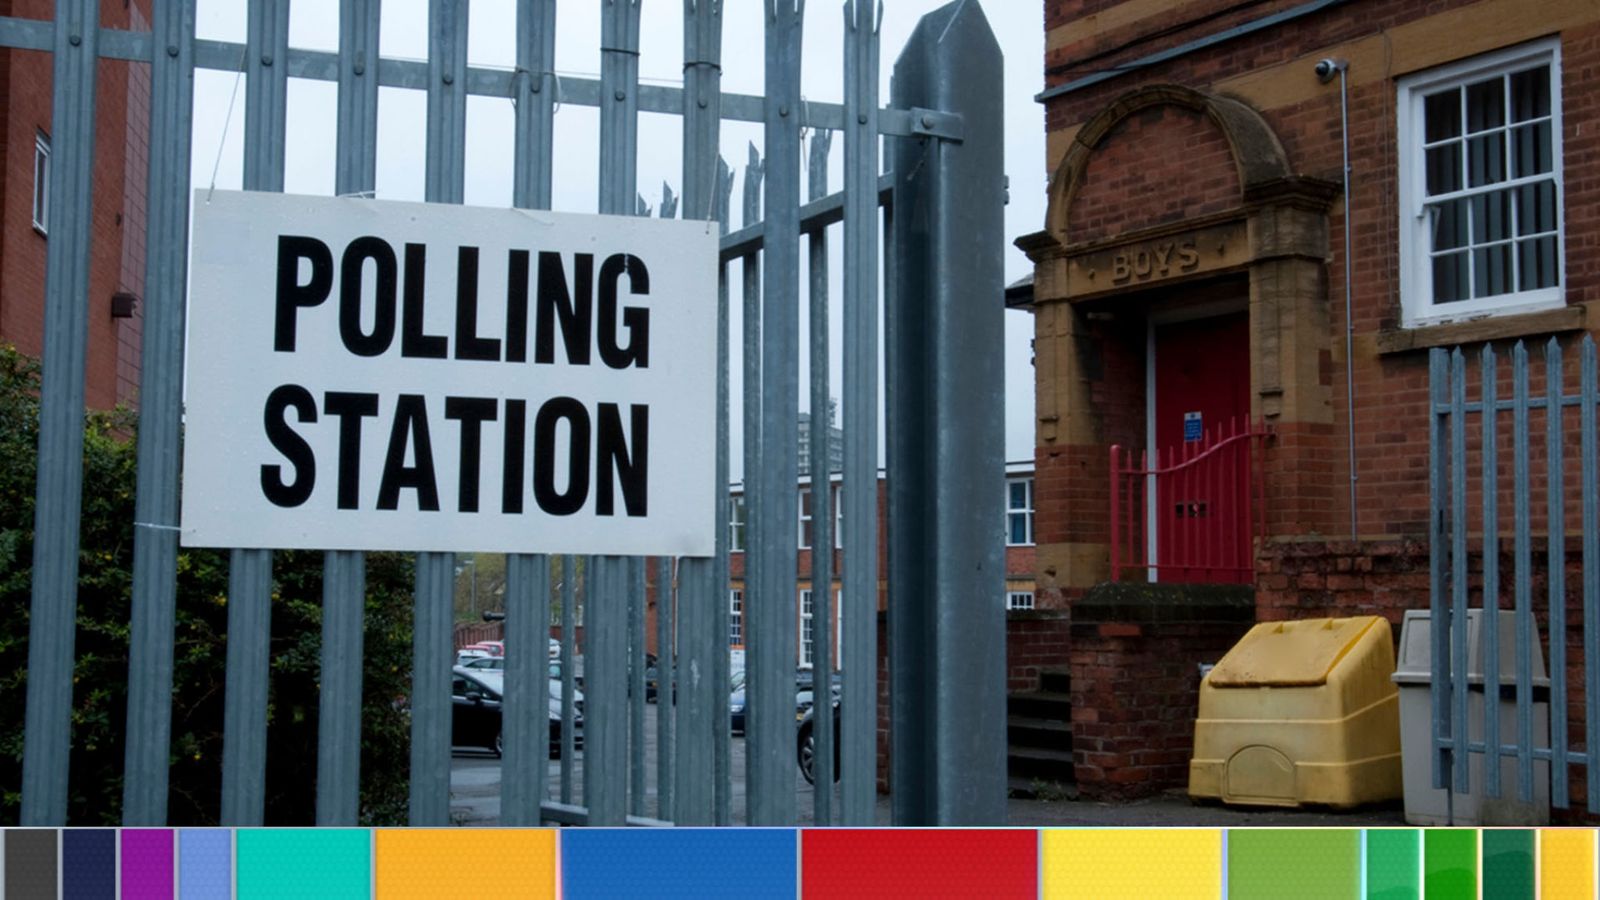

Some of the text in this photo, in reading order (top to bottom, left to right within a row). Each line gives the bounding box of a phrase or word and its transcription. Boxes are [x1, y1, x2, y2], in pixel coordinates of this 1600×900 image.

[274, 234, 650, 369] POLLING
[1112, 242, 1199, 285] BOYS
[260, 383, 650, 518] STATION
